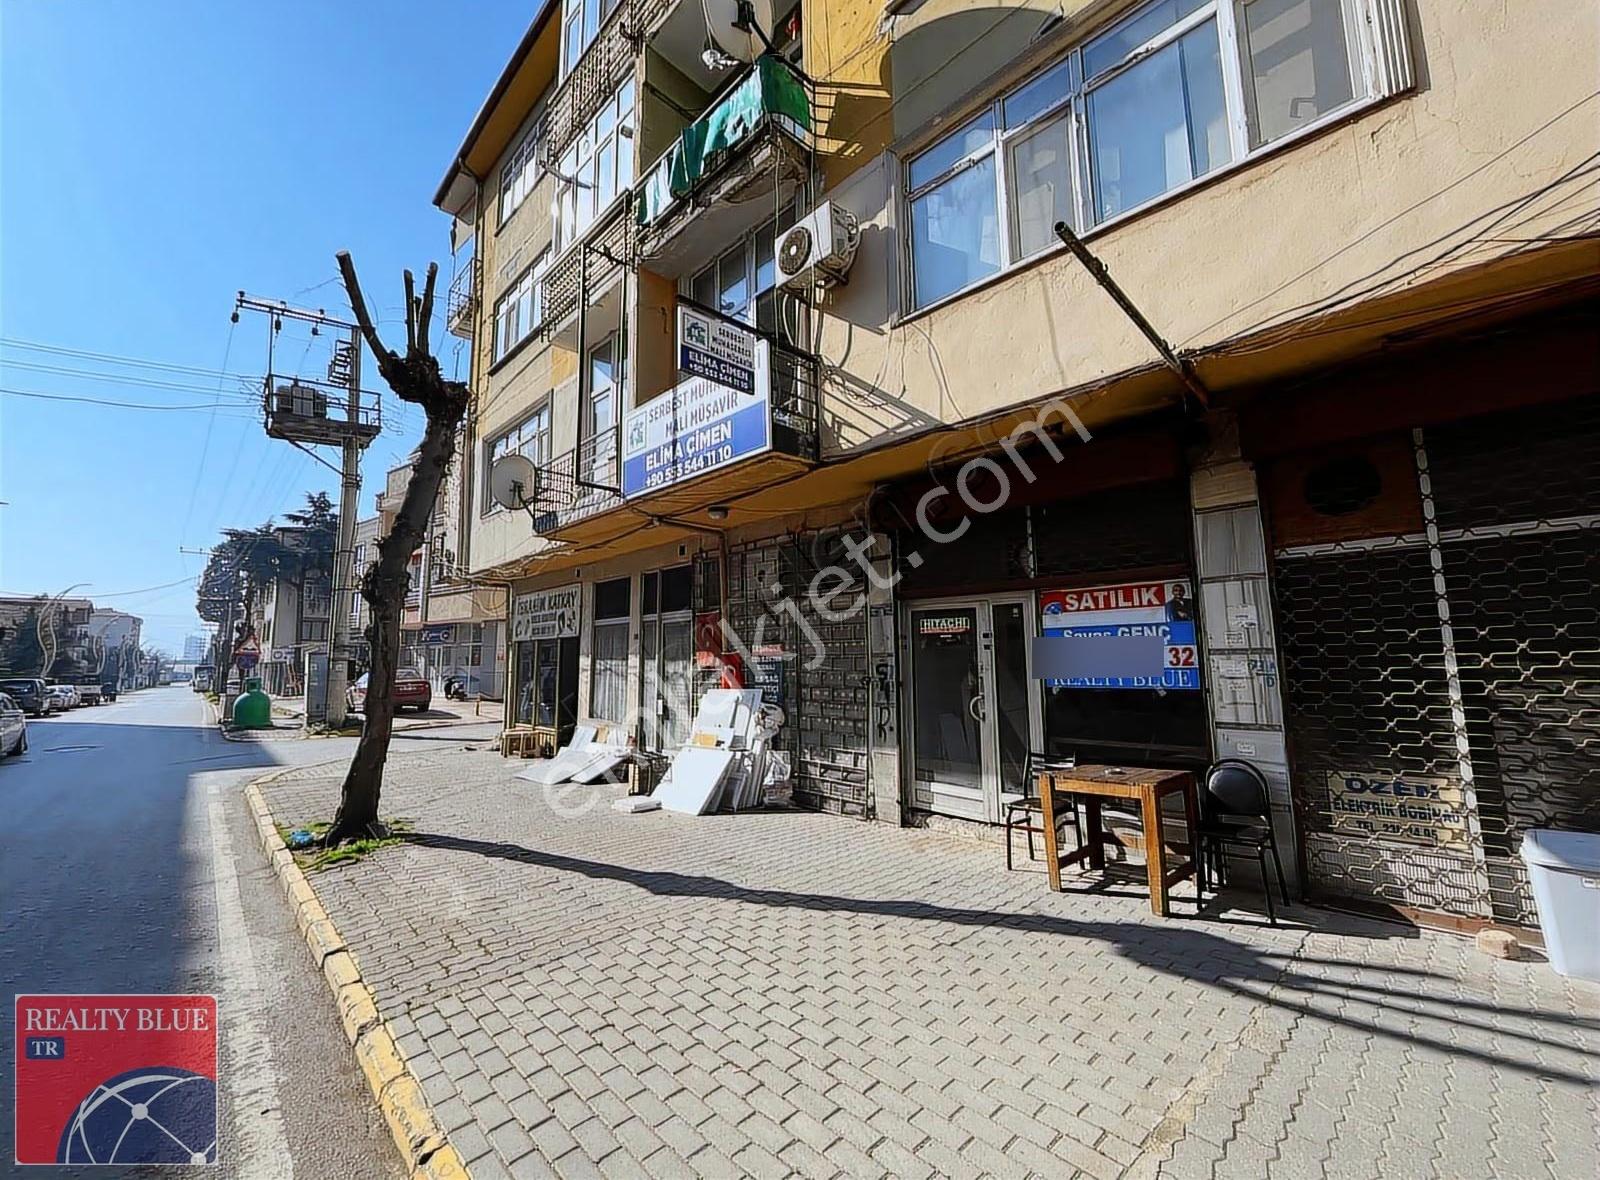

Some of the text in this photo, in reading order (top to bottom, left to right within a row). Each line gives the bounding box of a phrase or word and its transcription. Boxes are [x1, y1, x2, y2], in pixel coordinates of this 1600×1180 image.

[690, 391, 739, 426] MÜŞAVİR
[686, 420, 732, 458] ÇİMEN
[684, 455, 704, 475] 544
[1065, 586, 1160, 611] SATILIK
[1168, 647, 1195, 666] 32
